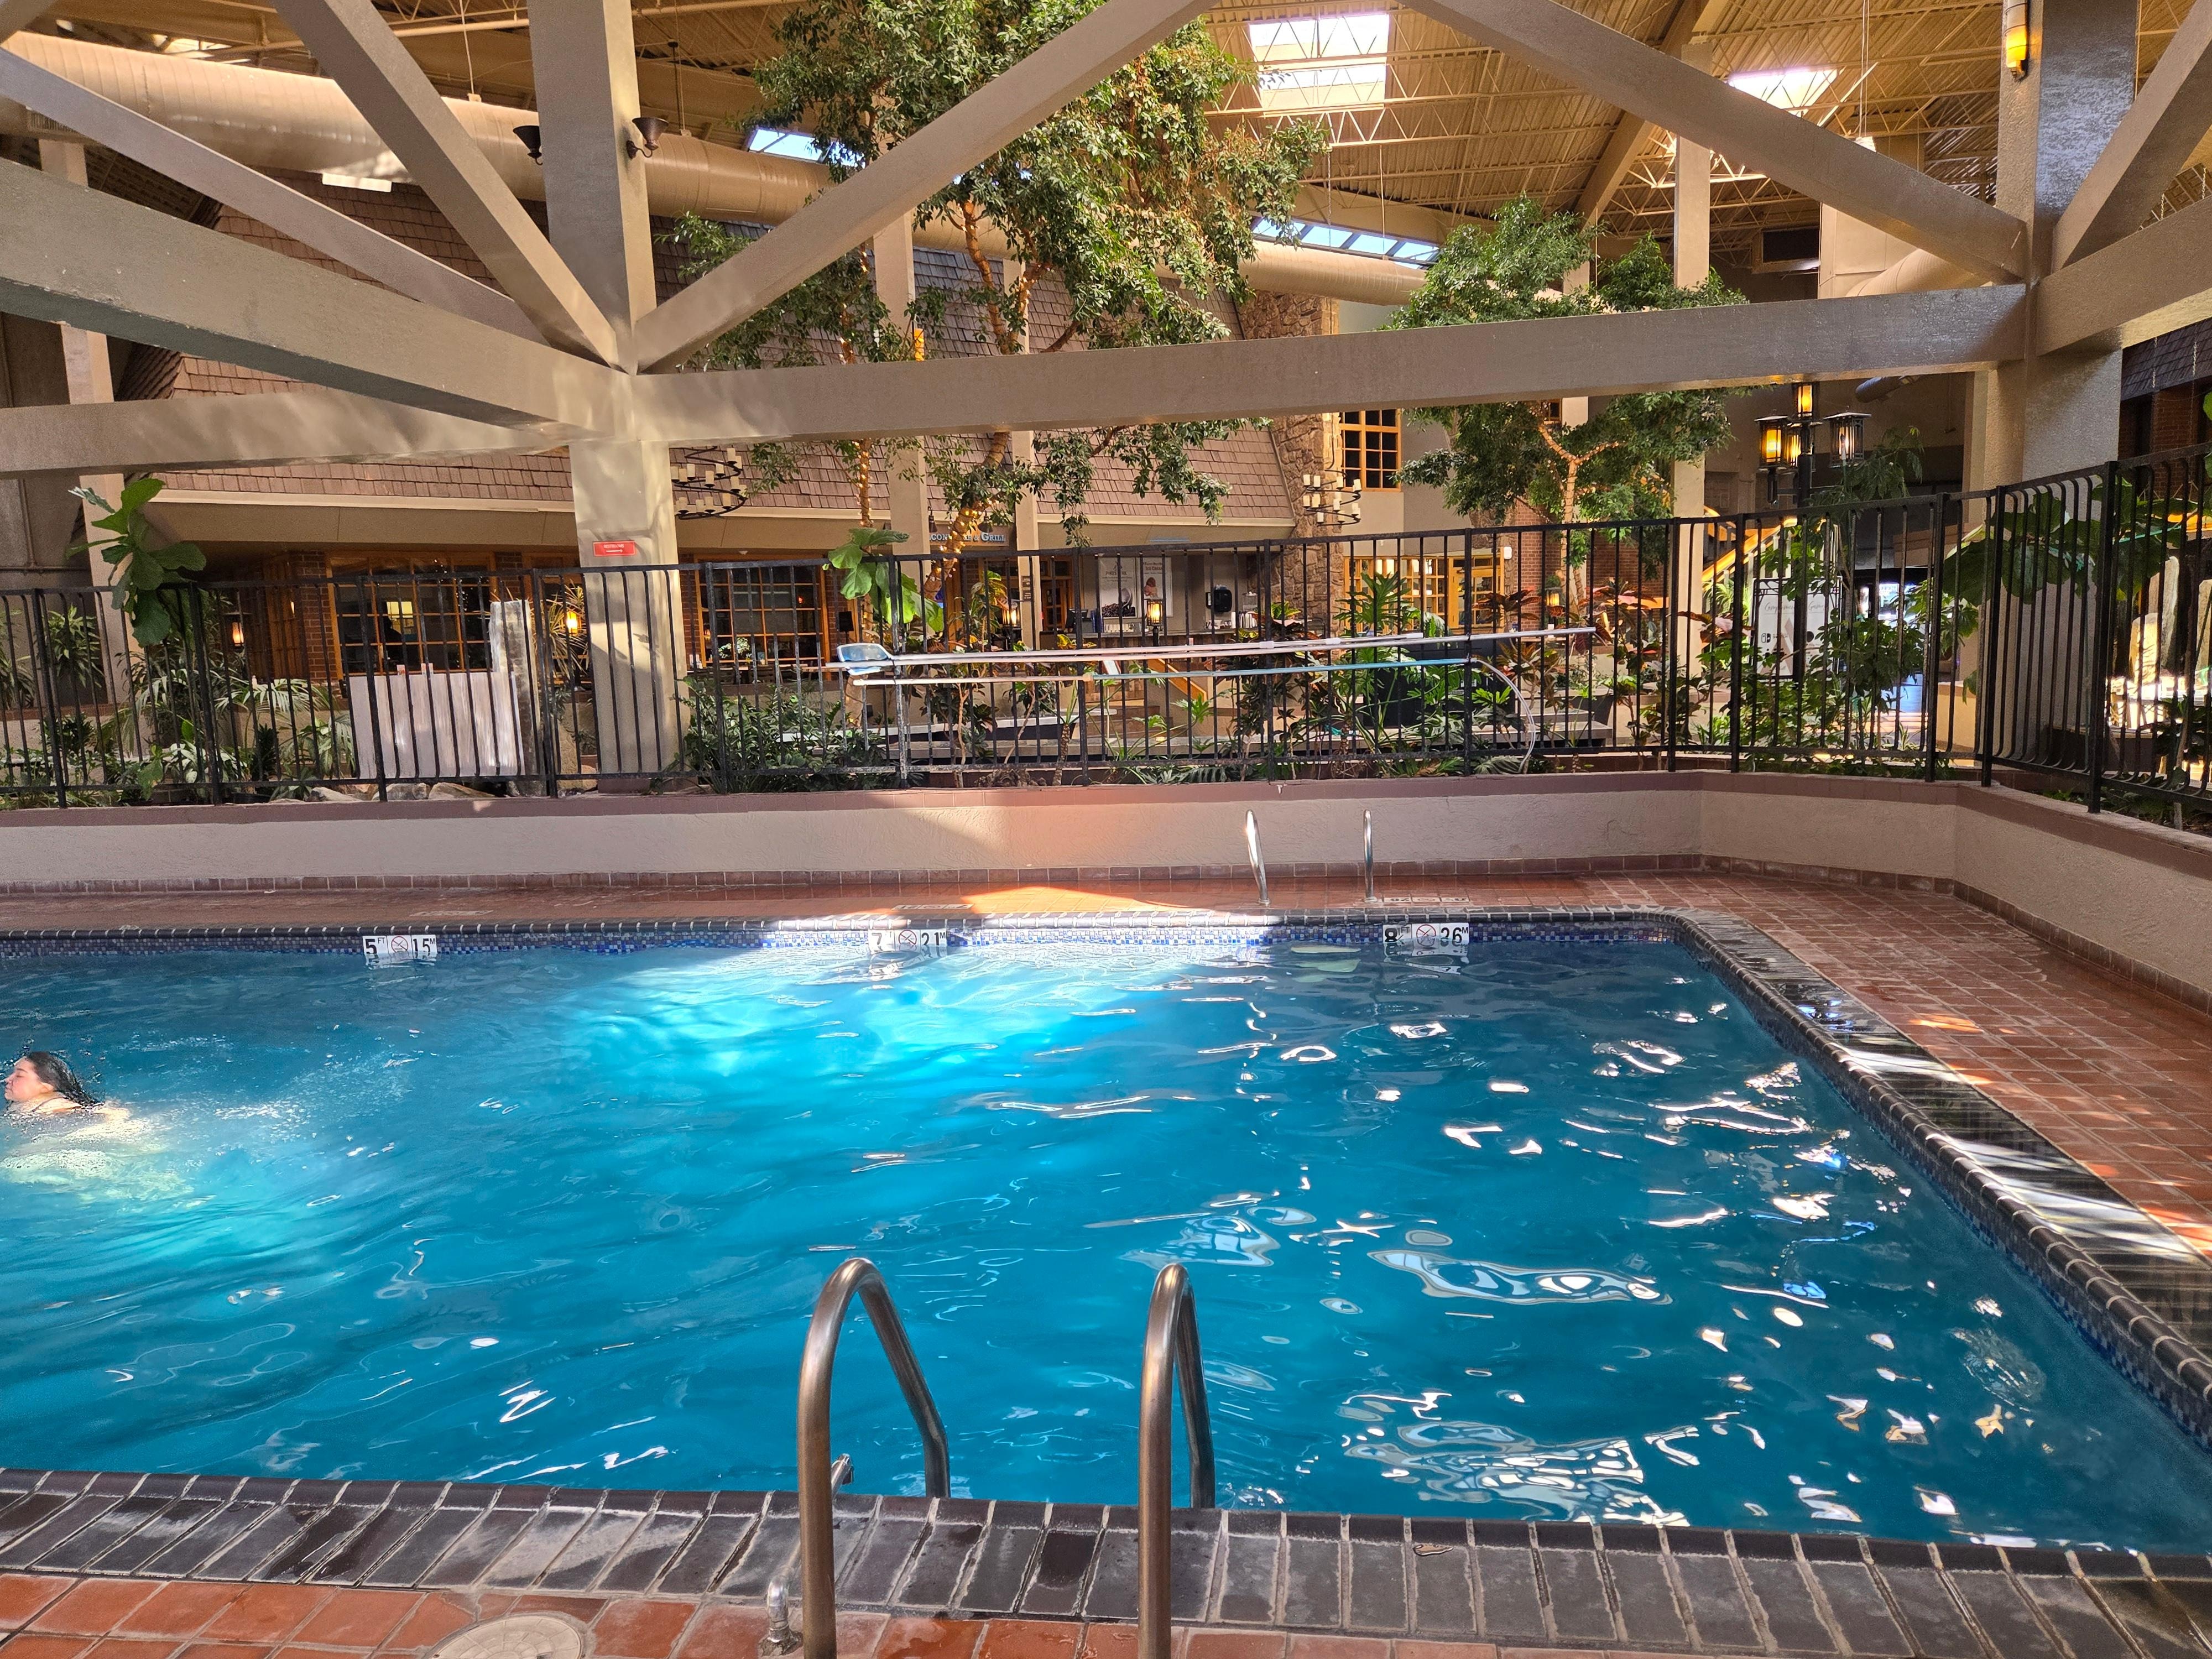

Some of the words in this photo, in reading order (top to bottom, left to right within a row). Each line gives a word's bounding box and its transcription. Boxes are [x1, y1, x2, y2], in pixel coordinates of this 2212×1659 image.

[981, 531, 1006, 541] GRILL
[872, 932, 882, 945] 7
[921, 932, 940, 946] 21
[1385, 928, 1397, 942] 8
[1441, 927, 1462, 943] 26
[365, 938, 377, 954] 5
[413, 938, 431, 952] 15
